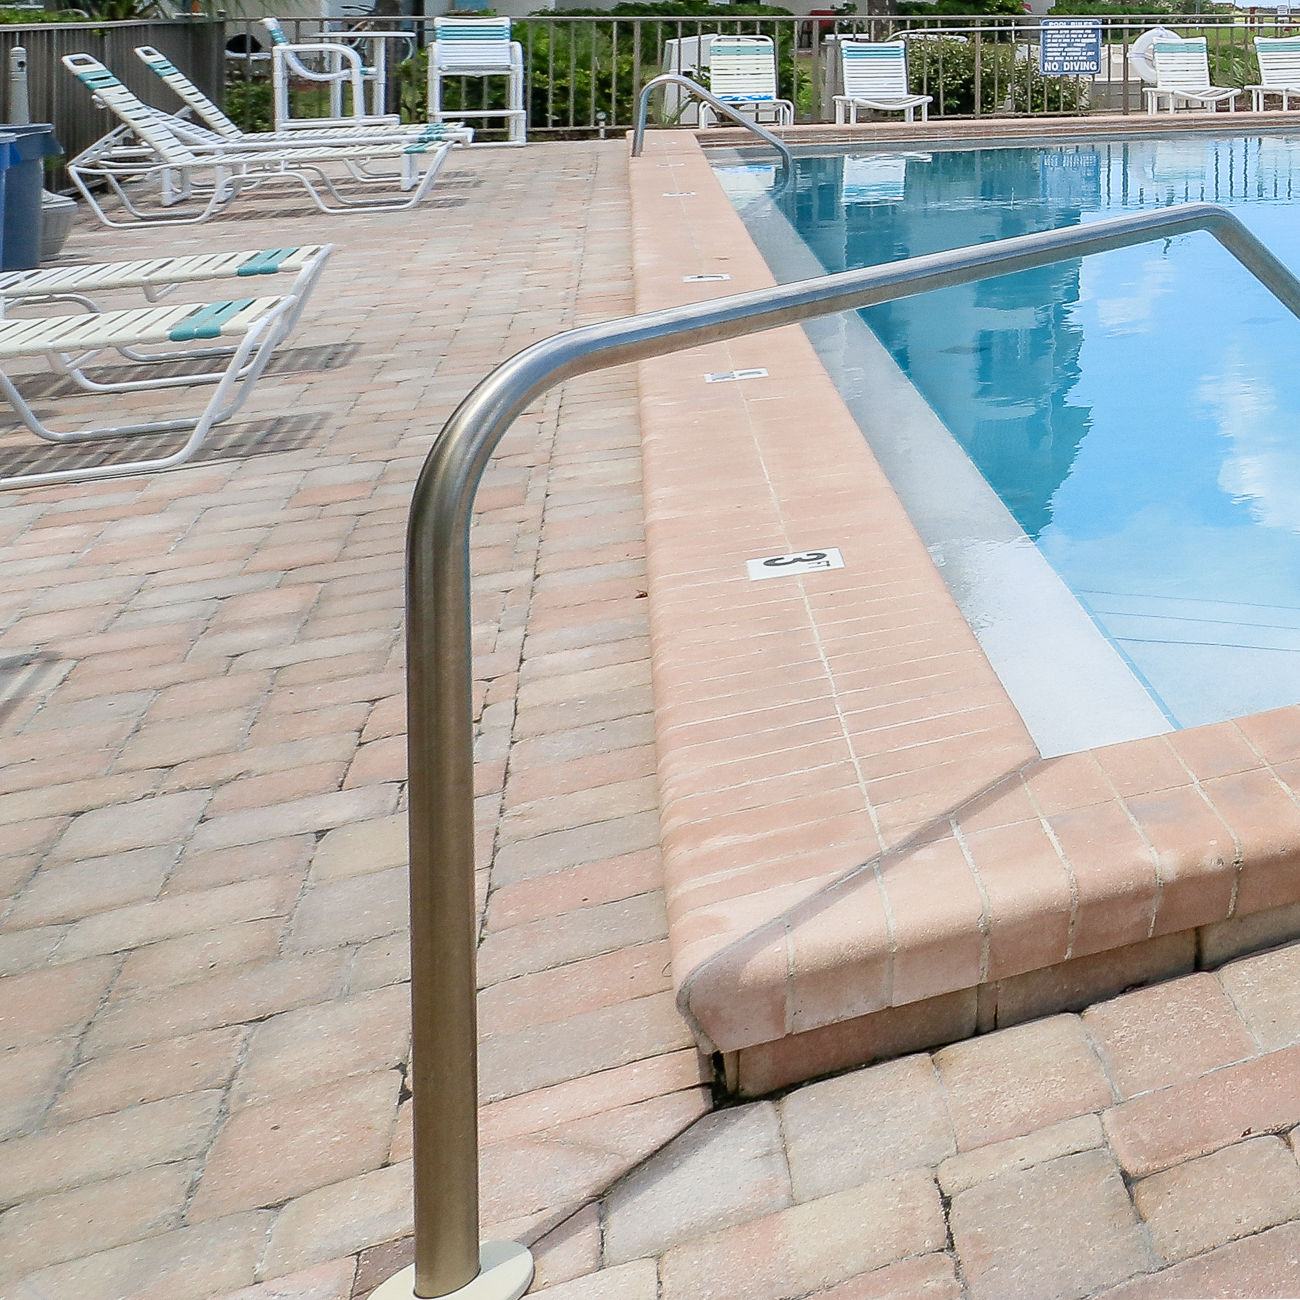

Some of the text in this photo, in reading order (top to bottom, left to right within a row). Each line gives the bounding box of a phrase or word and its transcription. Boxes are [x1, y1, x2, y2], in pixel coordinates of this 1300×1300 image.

[1044, 61, 1097, 71] NO DIVING
[763, 553, 827, 566] 3
